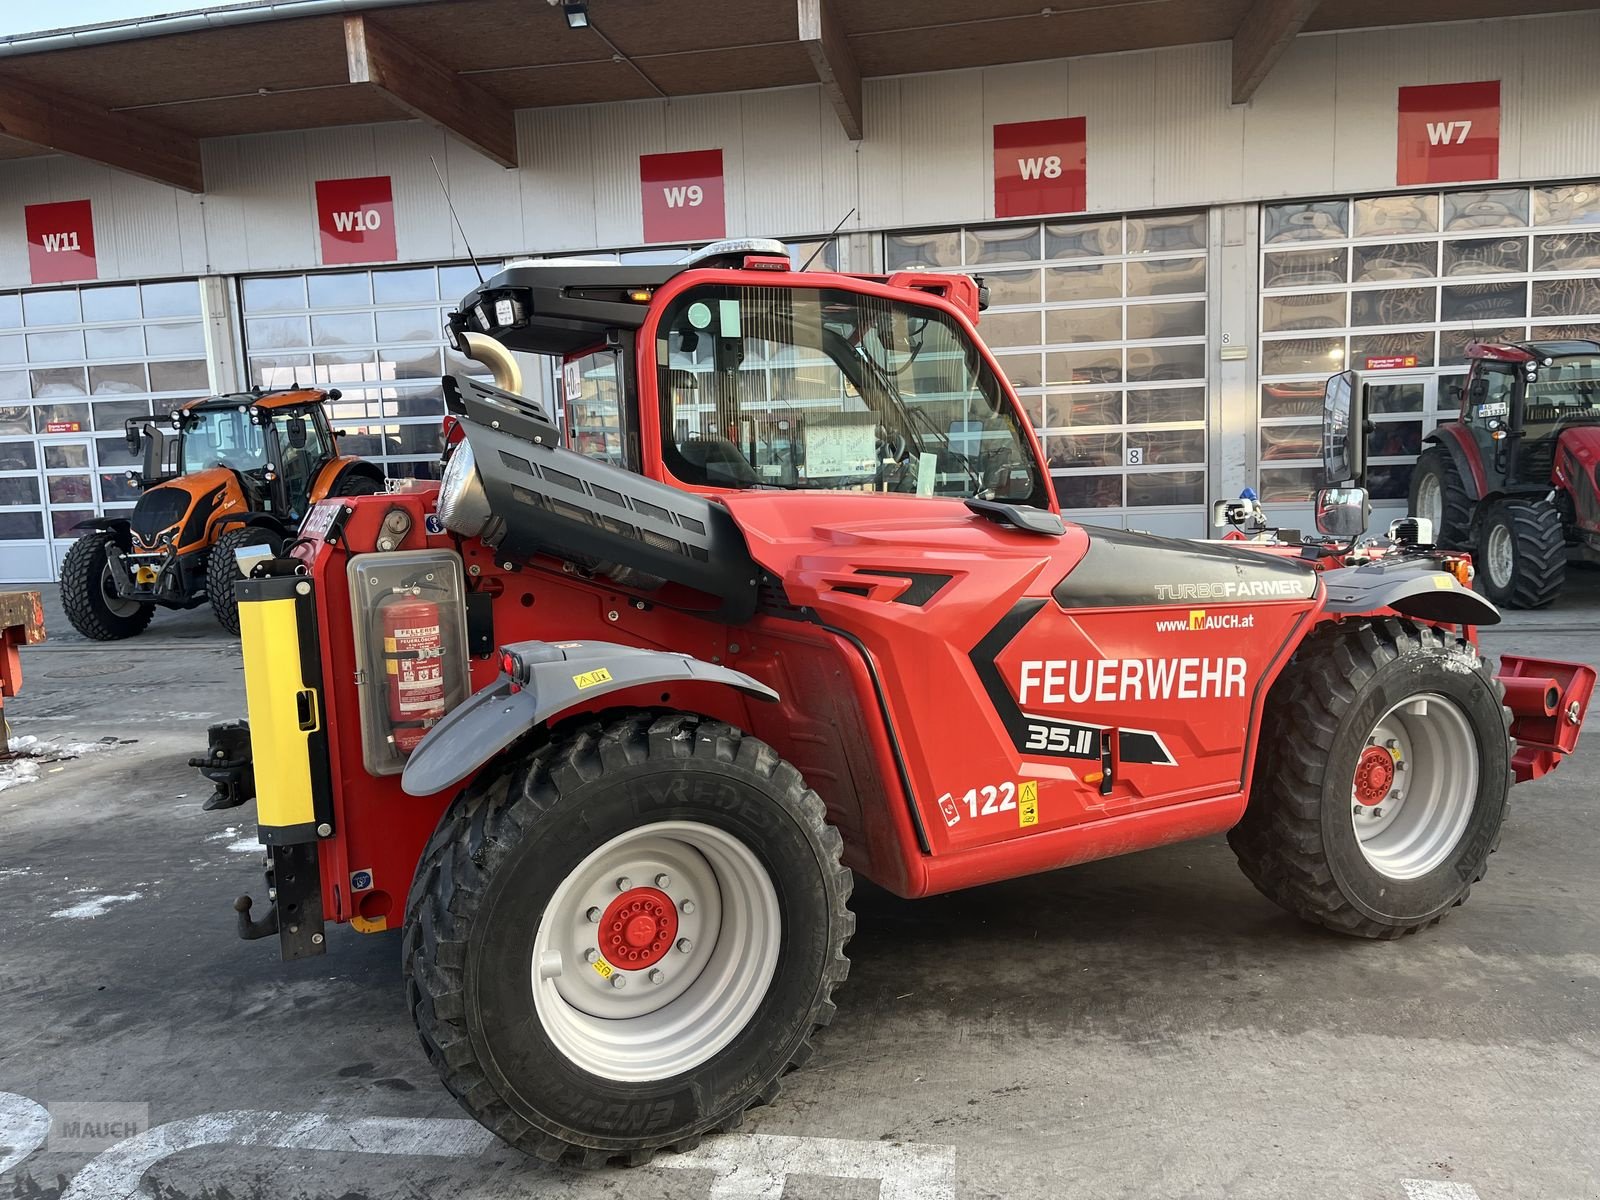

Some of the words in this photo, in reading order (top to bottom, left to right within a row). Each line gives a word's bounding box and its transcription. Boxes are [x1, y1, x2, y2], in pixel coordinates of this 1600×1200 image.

[1426, 121, 1472, 146] W7
[1018, 156, 1062, 181] W8
[663, 185, 703, 208] W9
[332, 209, 381, 232] W10
[42, 232, 81, 253] W11
[1222, 333, 1230, 344] 8
[1130, 450, 1139, 464] 8
[1154, 579, 1304, 600] TURBOFARMER
[1156, 613, 1254, 632] www.MAUCH.at
[1018, 656, 1247, 705] FEUERWEHR
[962, 781, 1017, 818] 122
